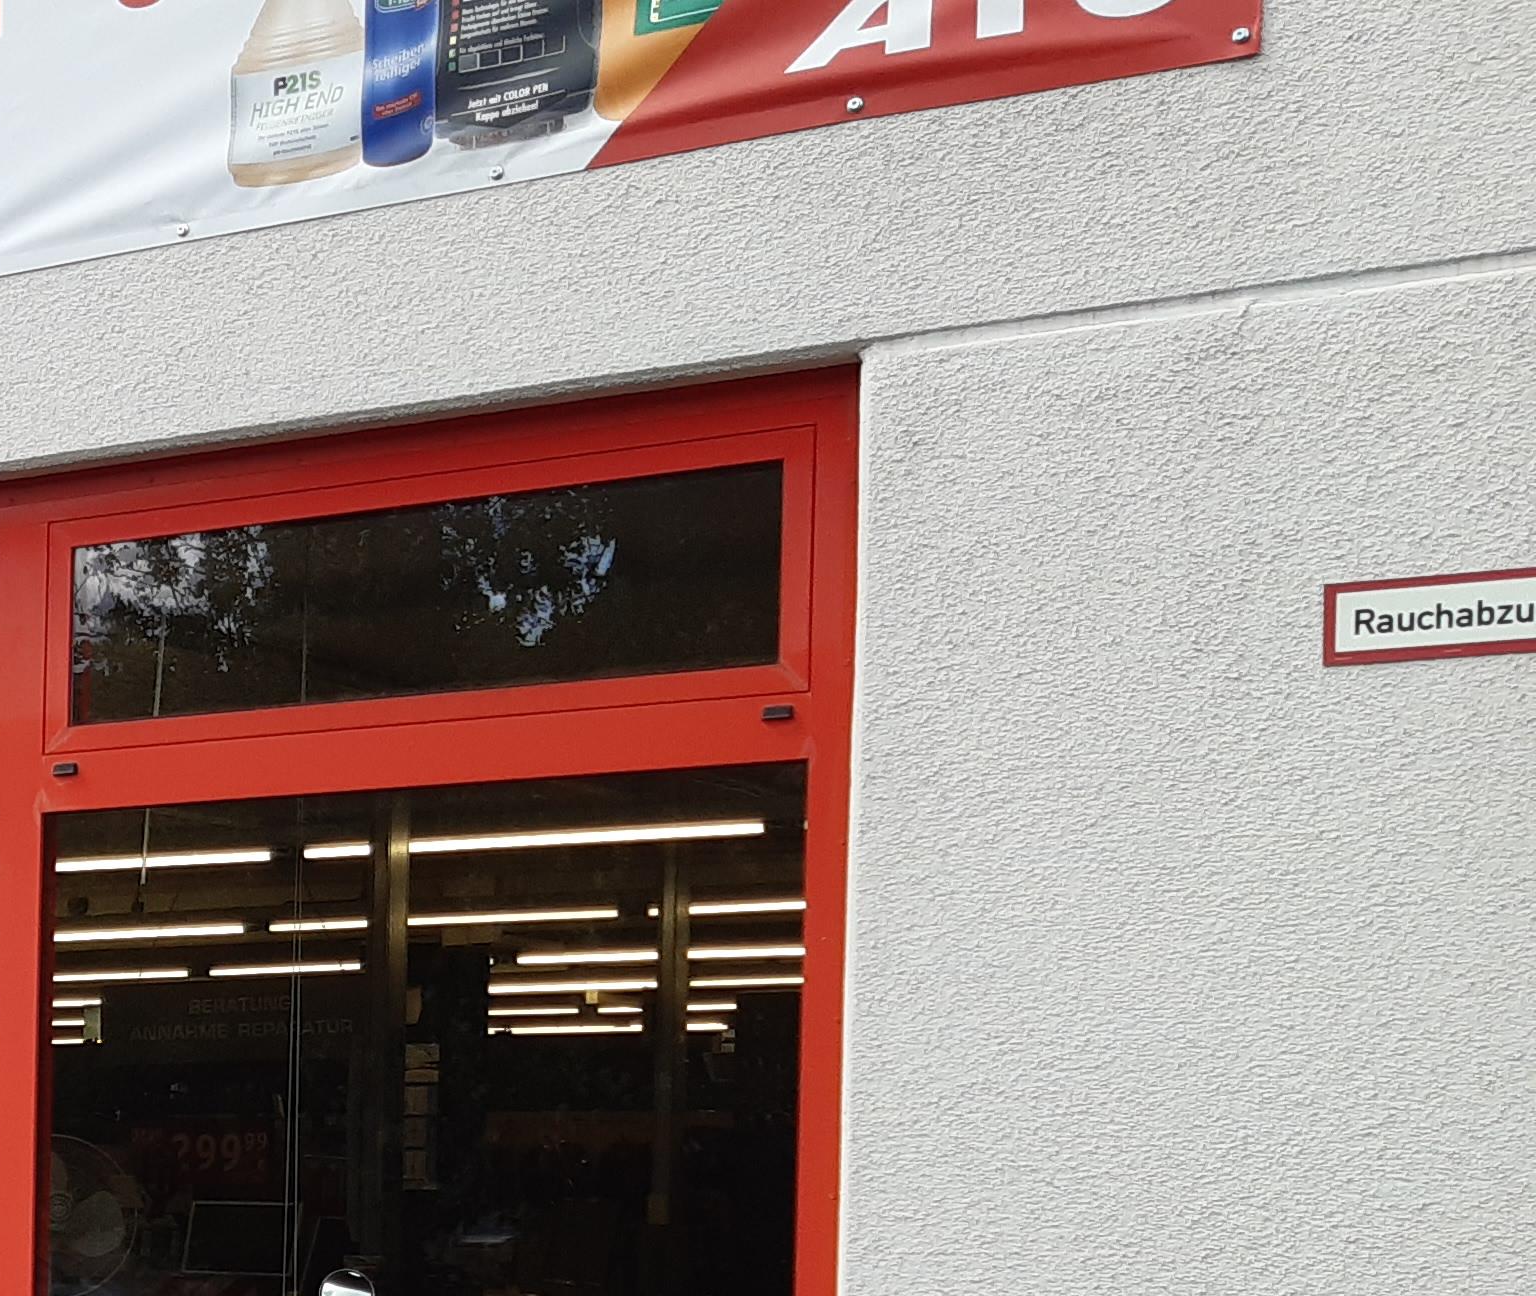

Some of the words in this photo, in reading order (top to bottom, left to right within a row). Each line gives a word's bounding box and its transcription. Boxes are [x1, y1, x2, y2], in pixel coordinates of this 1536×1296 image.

[503, 86, 531, 101] COLOR
[532, 82, 549, 95] PEN
[1353, 599, 1535, 636] Rauchabzu
[236, 1018, 354, 1039] REPAATUR
